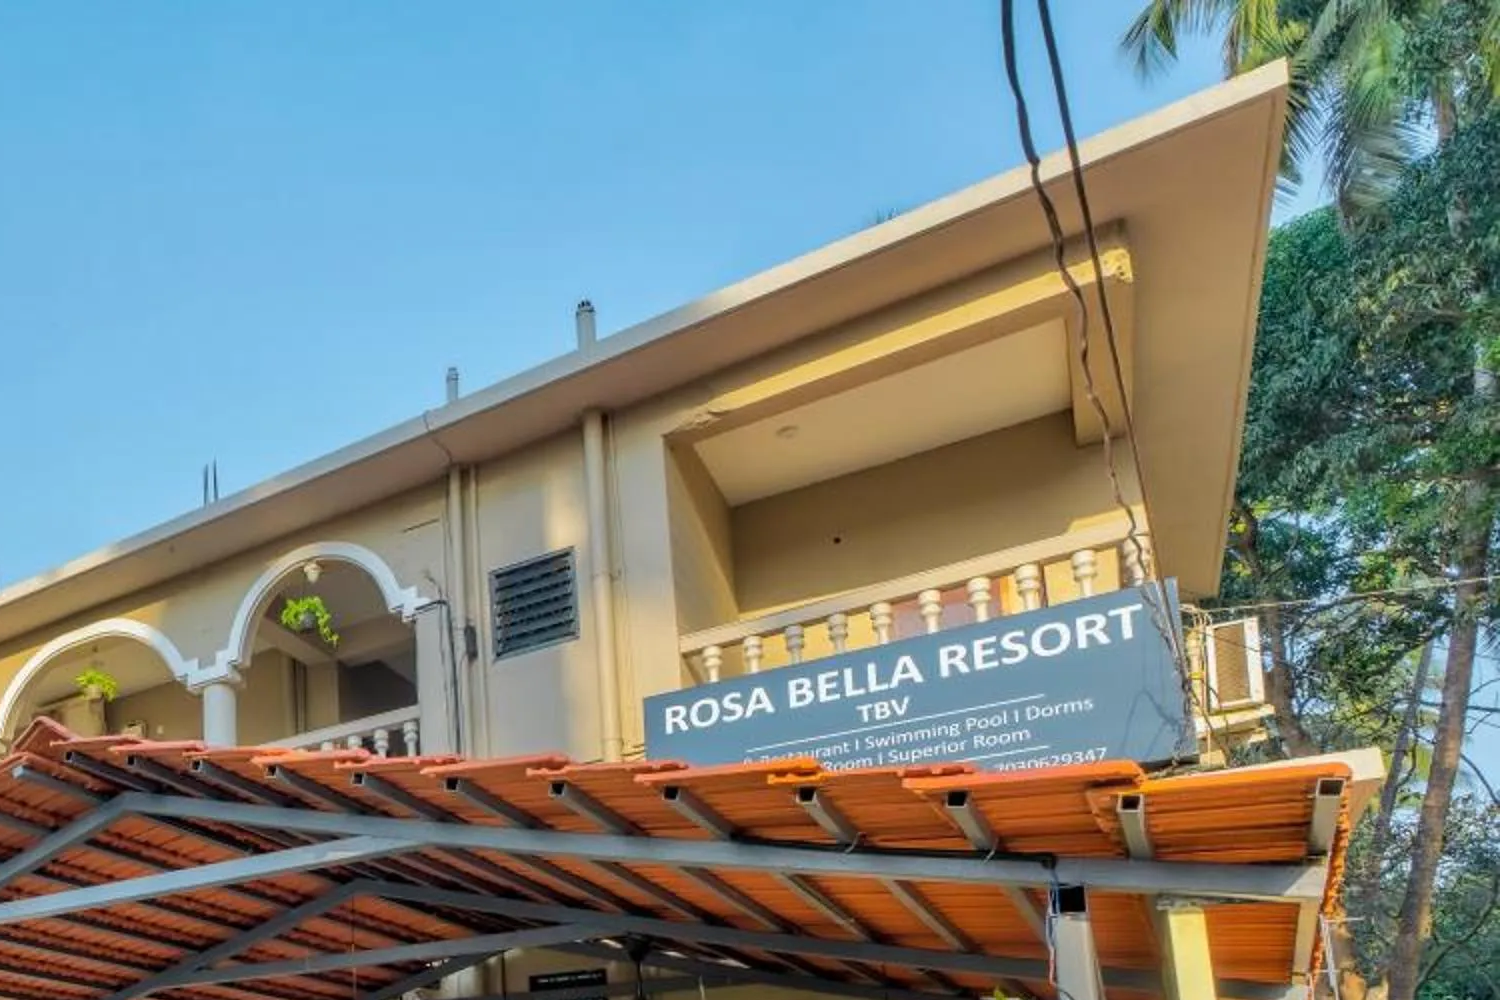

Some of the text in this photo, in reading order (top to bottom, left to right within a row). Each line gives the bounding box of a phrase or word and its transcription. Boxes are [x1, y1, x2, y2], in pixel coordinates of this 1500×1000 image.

[665, 603, 1143, 736] ROSA BELLA RESORT
[856, 696, 910, 723] TBV
[865, 723, 959, 749] Swimming
[967, 712, 1007, 731] Pool
[1025, 698, 1094, 721] Dorms
[888, 740, 966, 763] Superior
[973, 728, 1032, 749] Room
